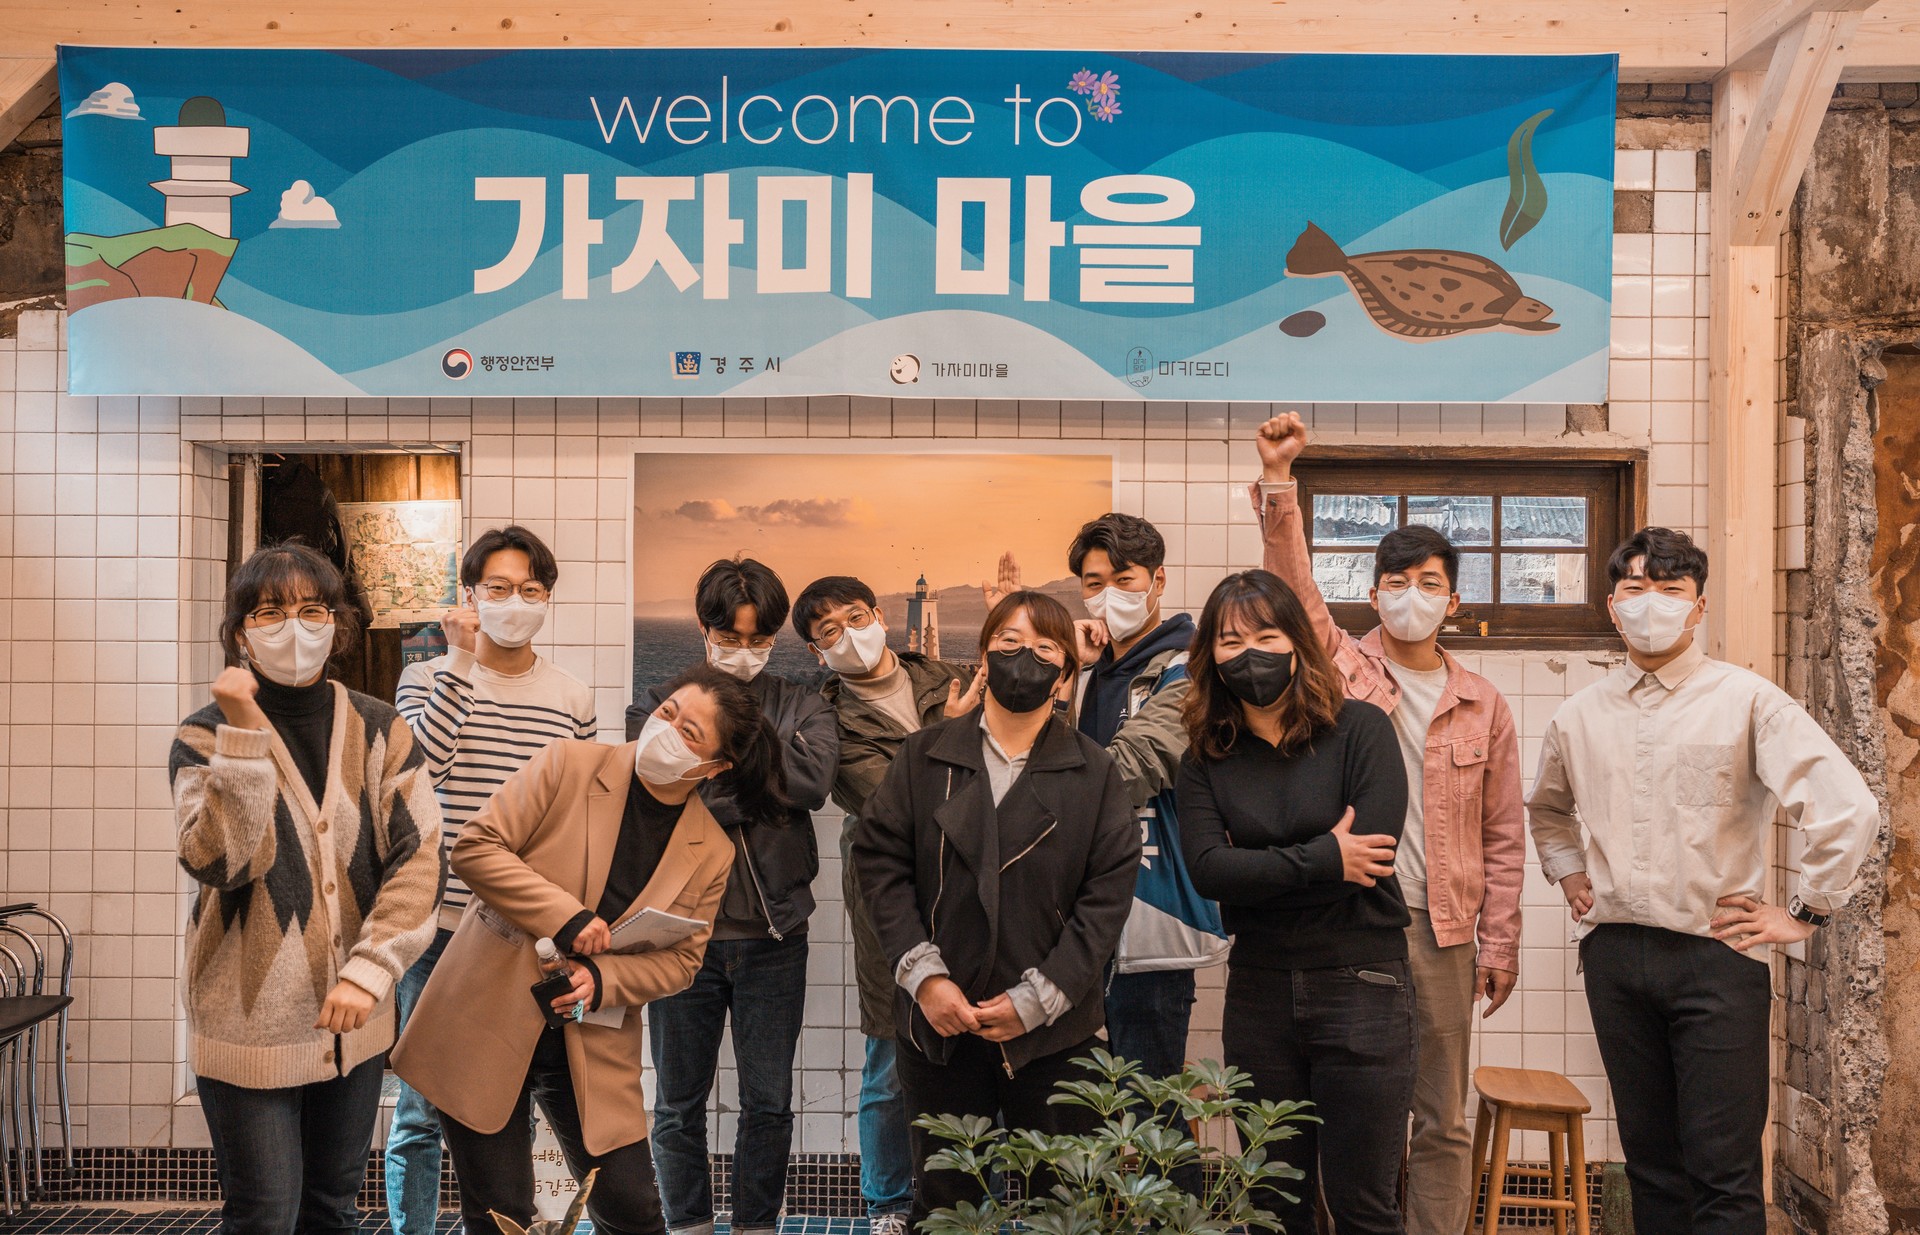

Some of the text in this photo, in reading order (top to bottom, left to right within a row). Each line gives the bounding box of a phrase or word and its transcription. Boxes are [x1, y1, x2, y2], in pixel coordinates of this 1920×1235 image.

[589, 76, 1082, 147] welcome to
[474, 173, 1201, 303] 가자미 마을
[480, 355, 555, 372] 행정안전부
[931, 362, 1009, 378] 가자미마을
[1159, 360, 1230, 377] 마카모디
